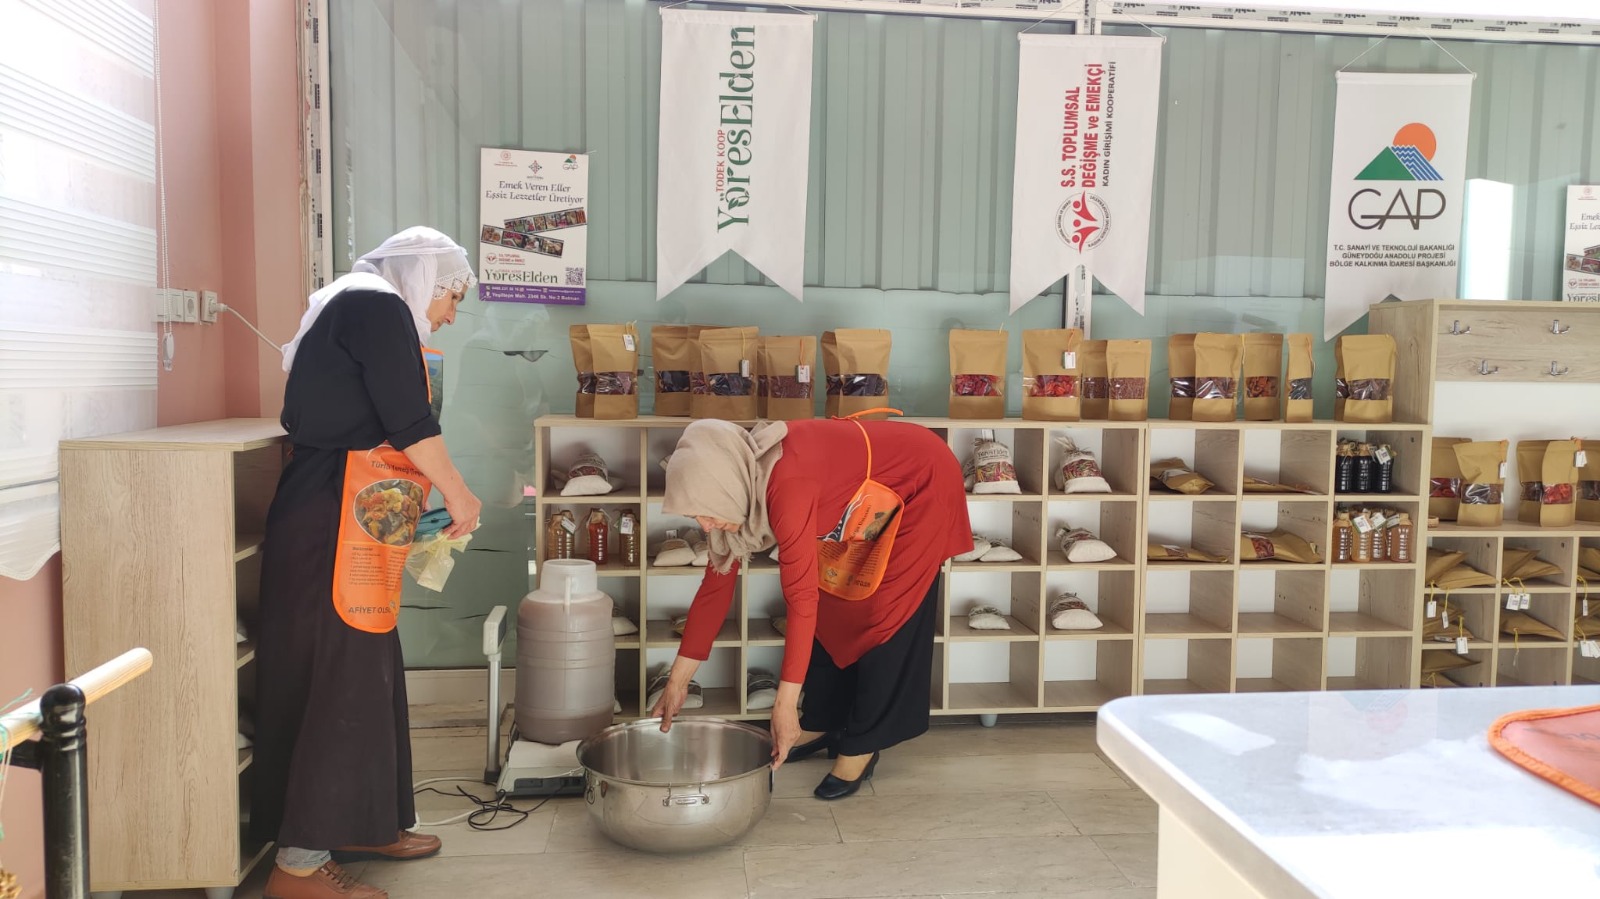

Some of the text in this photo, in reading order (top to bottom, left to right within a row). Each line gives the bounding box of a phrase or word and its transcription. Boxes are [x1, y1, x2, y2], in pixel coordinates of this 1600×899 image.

[1106, 61, 1117, 119] KOOPERATİFİ
[717, 24, 755, 234] YöresElden
[1062, 86, 1080, 161] TOPLUMSAL
[1079, 62, 1106, 188] DEĞİŞME ve EMEKÇİ
[1103, 120, 1113, 158] GİRİŞİMİ
[715, 129, 726, 193] TODEK KOOP
[1061, 163, 1076, 188] S.S.
[486, 190, 584, 206] Eşsiz Lezzetler Üretiyor
[499, 180, 571, 192] Emek Veren Eller
[1347, 187, 1447, 231] GAP
[1347, 243, 1371, 251] SANAYİ
[1419, 243, 1455, 251] BAKANLIĞI
[1416, 260, 1456, 268] BAŞKANLIĞI
[348, 605, 376, 614] AFİYET
